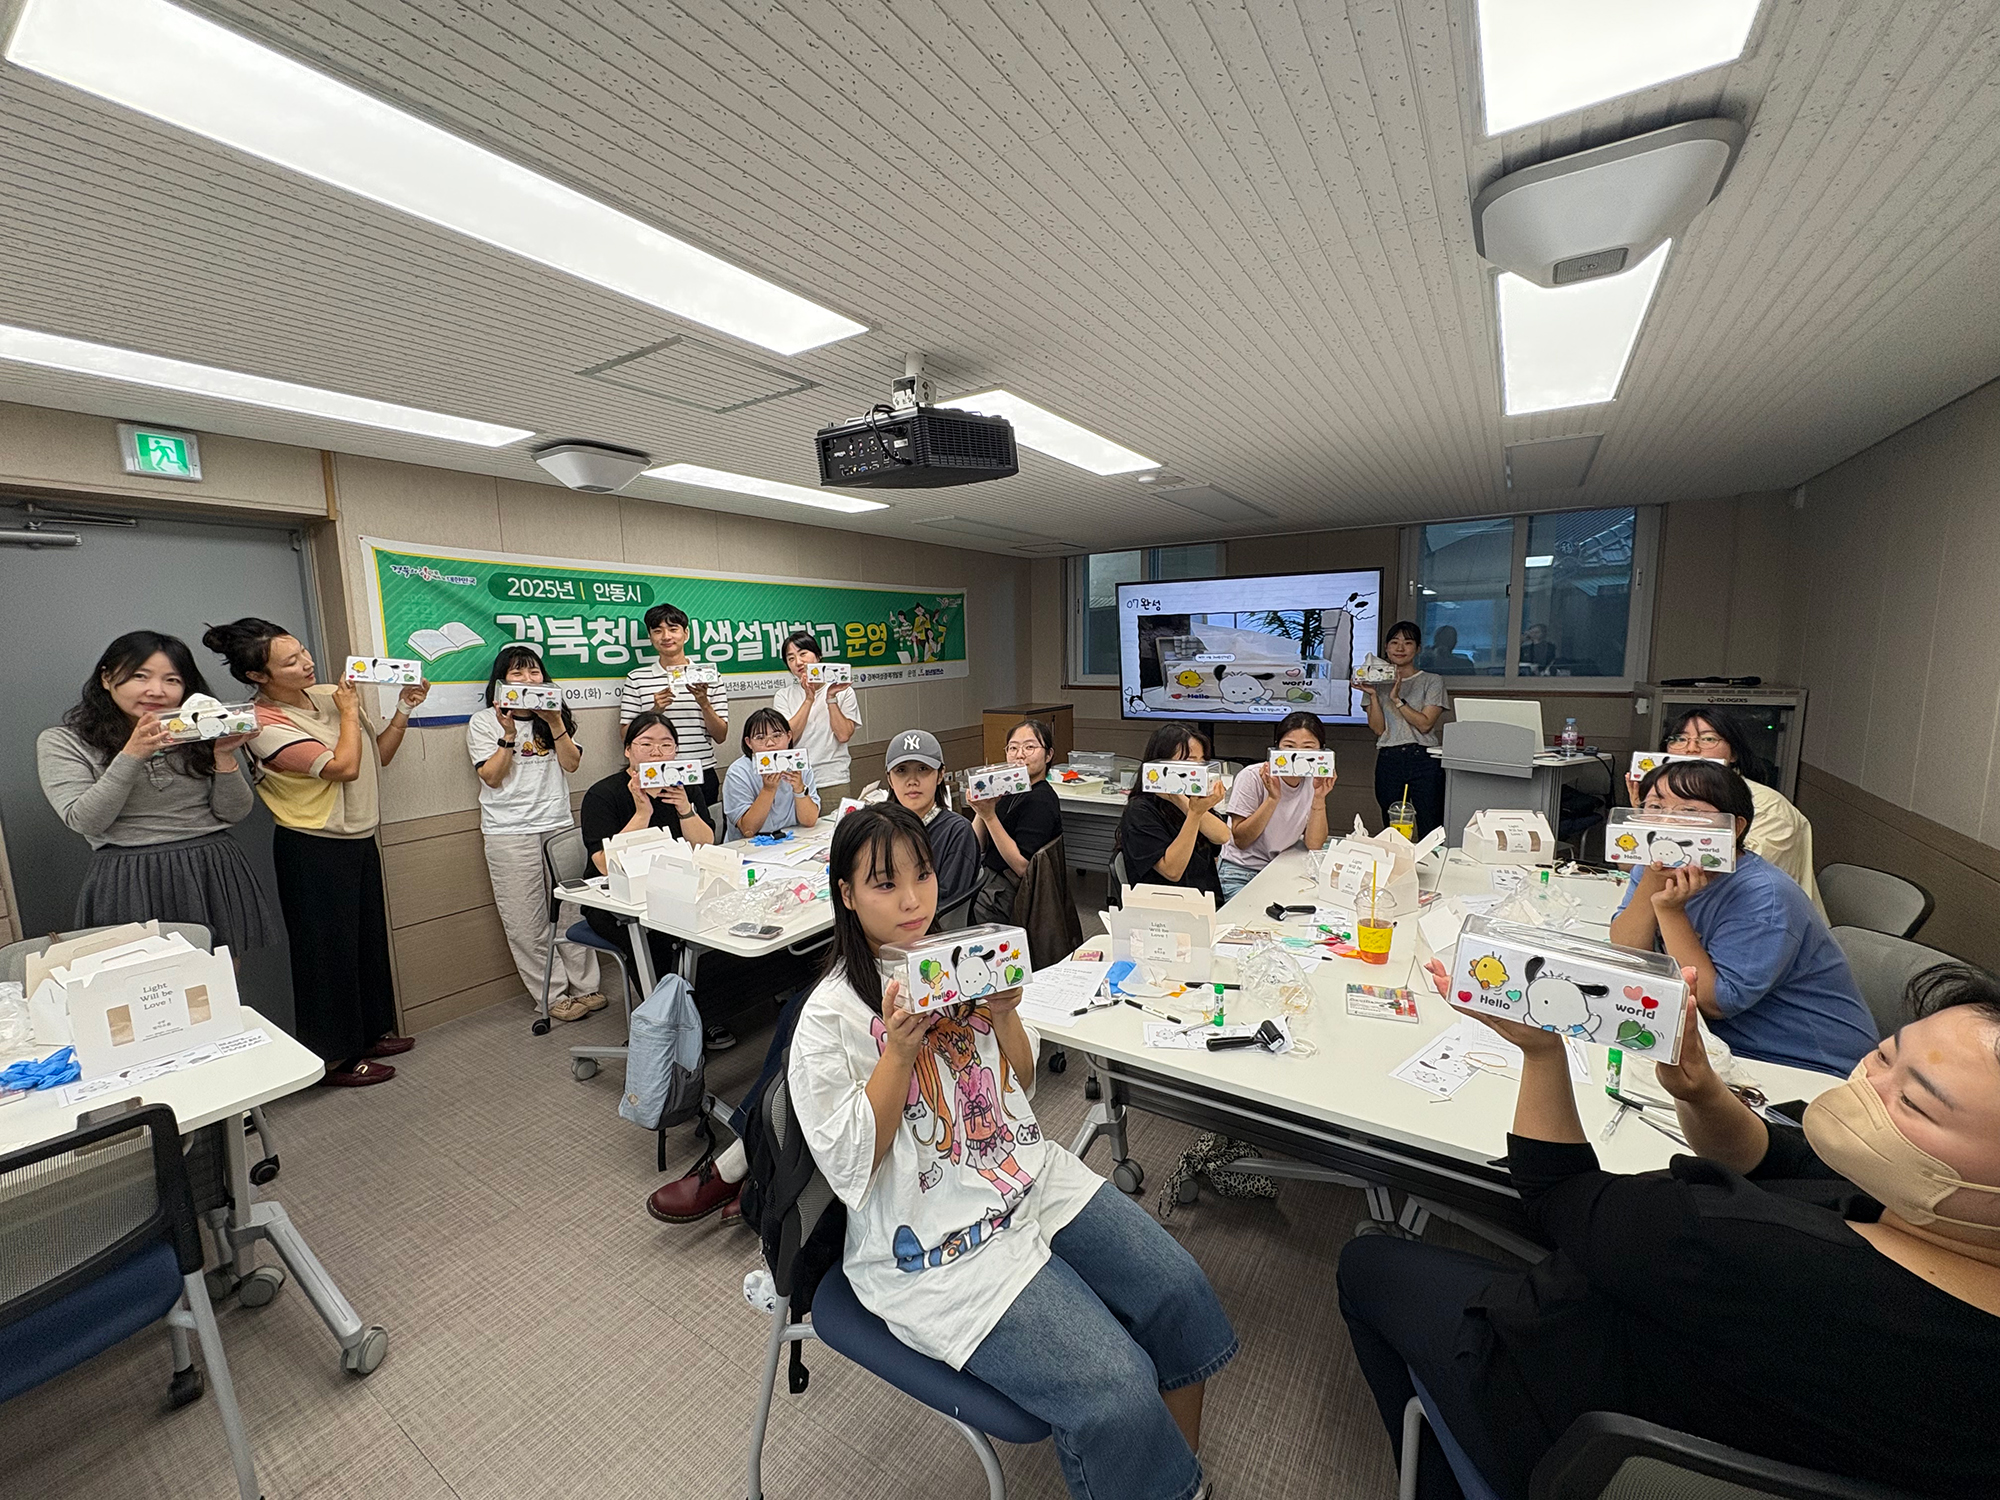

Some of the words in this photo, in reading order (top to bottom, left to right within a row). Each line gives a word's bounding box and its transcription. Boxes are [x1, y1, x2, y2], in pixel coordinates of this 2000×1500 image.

[507, 577, 576, 600] 2025년
[593, 581, 642, 603] 안동시
[1126, 598, 1139, 609] 07
[1140, 597, 1162, 612] 완성
[496, 614, 841, 666] 경북청생설계교
[845, 621, 888, 658] 운영
[565, 687, 602, 700] 09.(화)
[1000, 953, 1019, 963] world
[142, 982, 168, 994] Light
[139, 992, 160, 1002] Will
[1479, 994, 1511, 1011] Hello
[143, 1000, 167, 1010] Love
[1615, 1002, 1656, 1020] world
